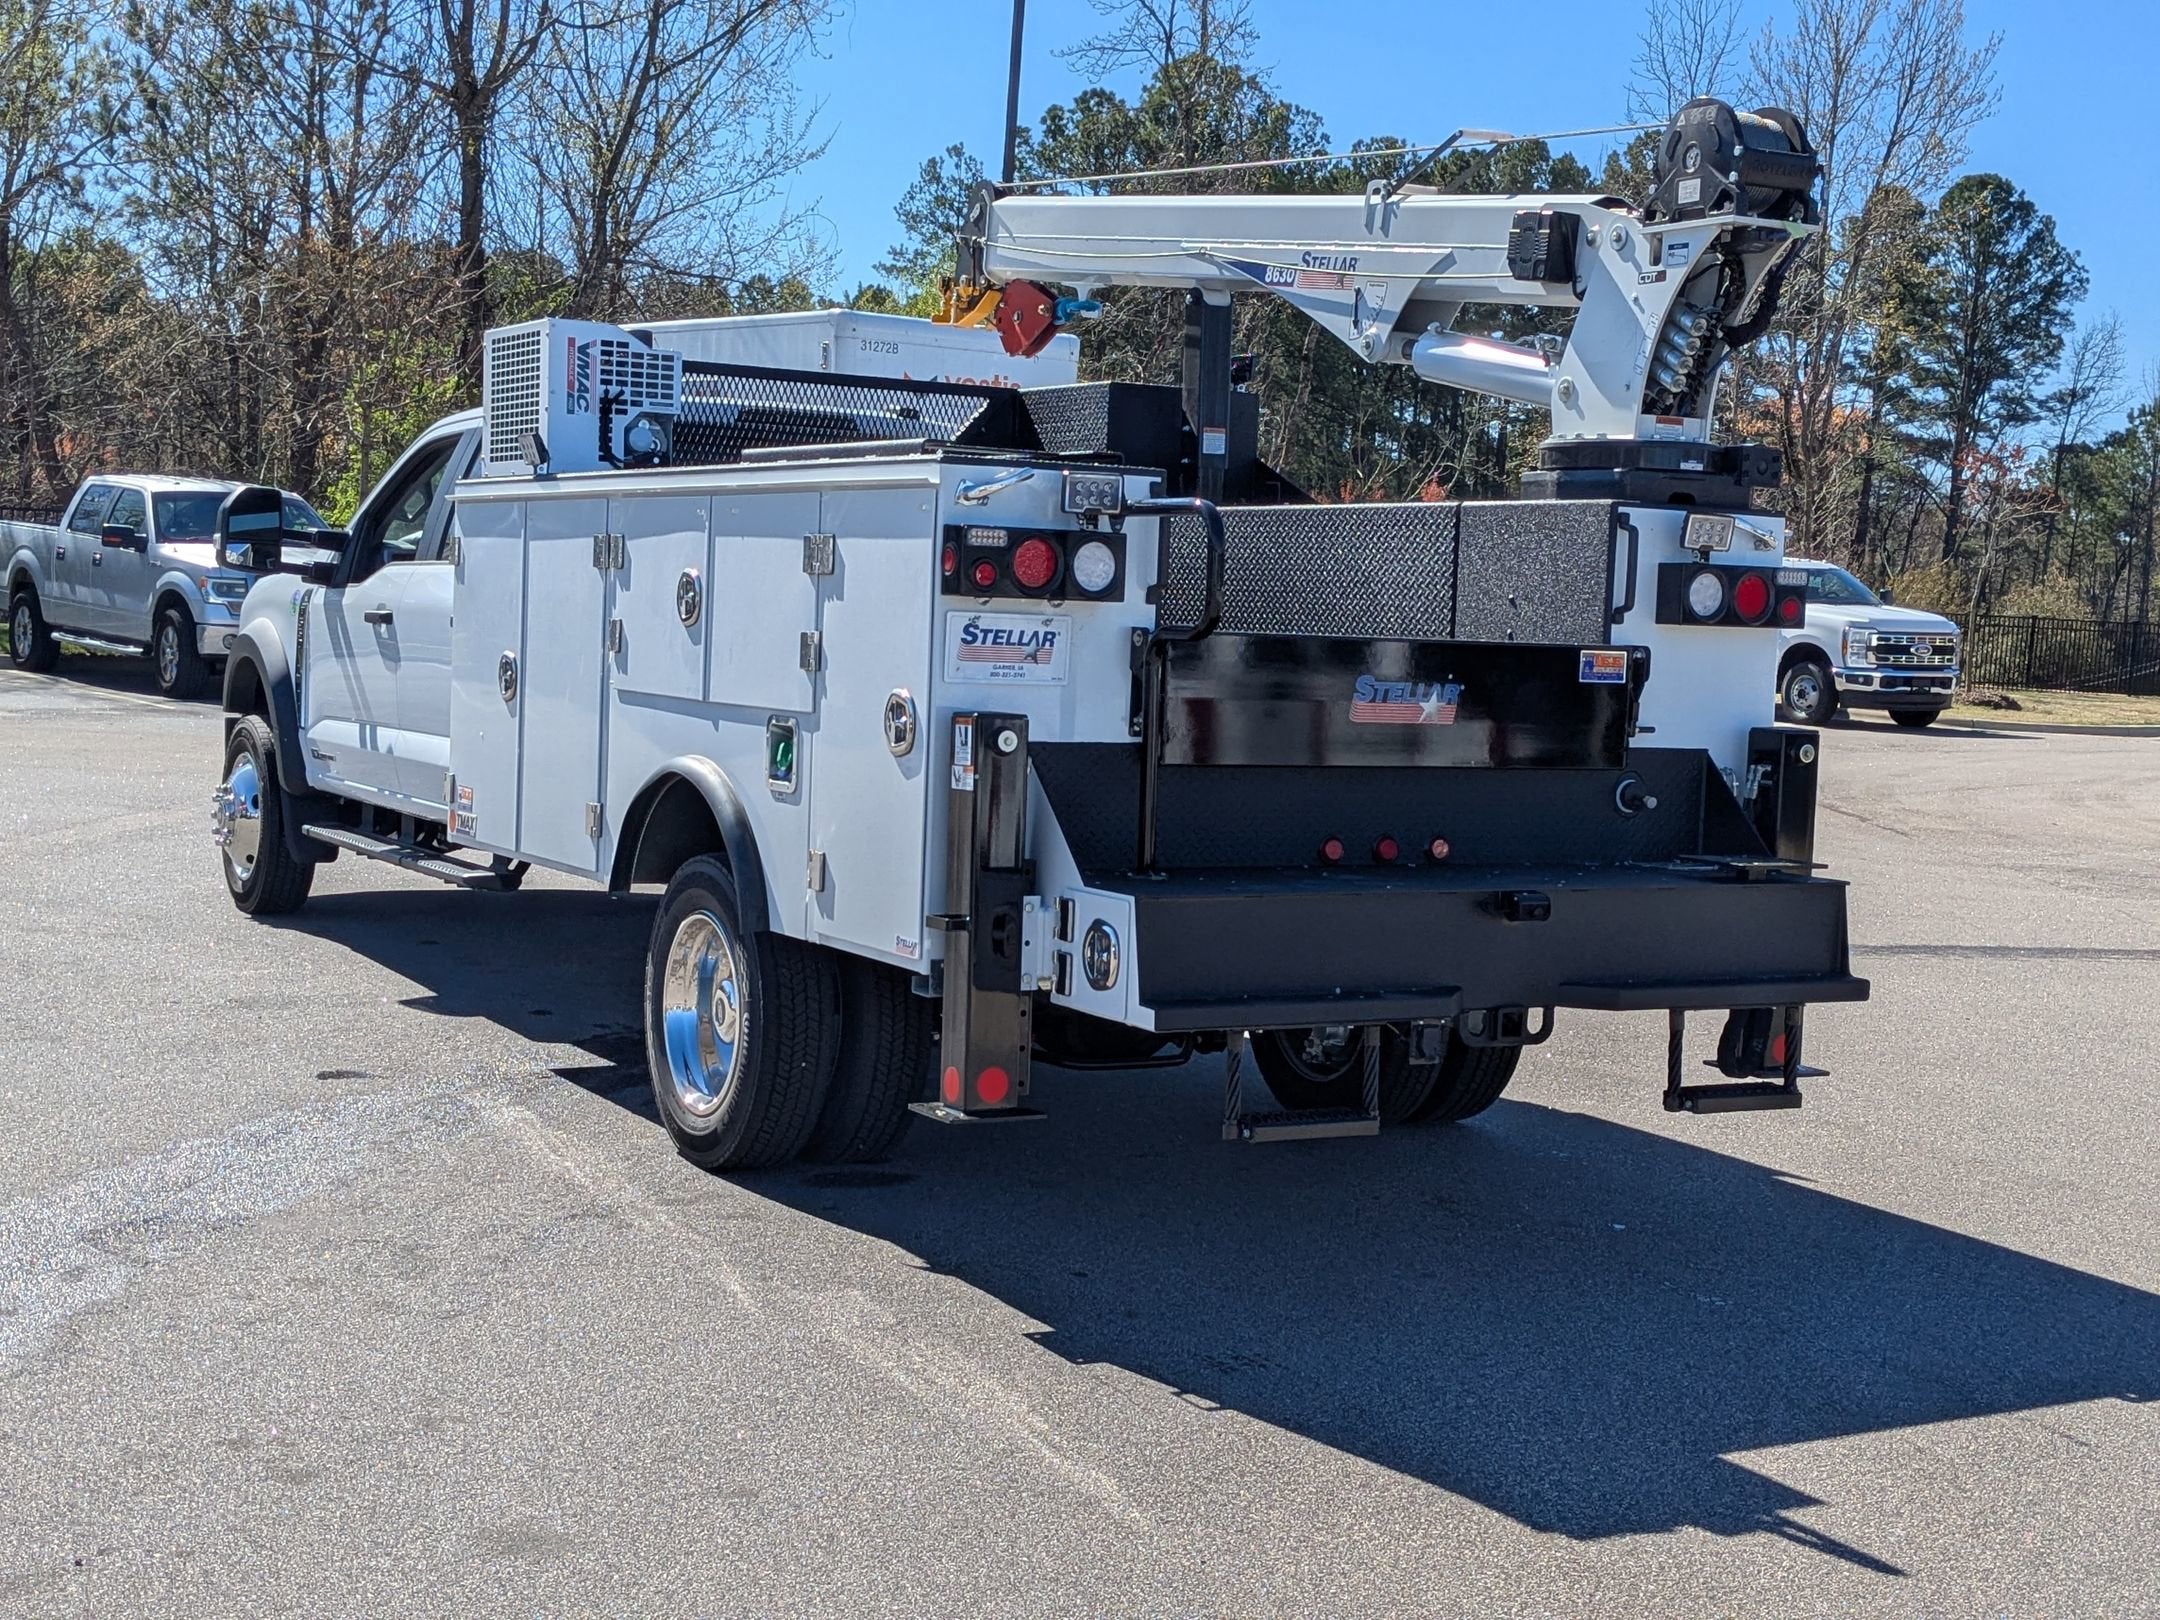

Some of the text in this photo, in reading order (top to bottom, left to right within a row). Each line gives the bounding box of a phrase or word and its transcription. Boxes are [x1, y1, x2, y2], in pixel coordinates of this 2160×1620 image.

[1301, 251, 1357, 272] STELLAR
[1265, 266, 1295, 283] 8630
[576, 342, 590, 413] VMAC
[961, 622, 1057, 647] STELLAR
[1354, 674, 1460, 704] STELLAR
